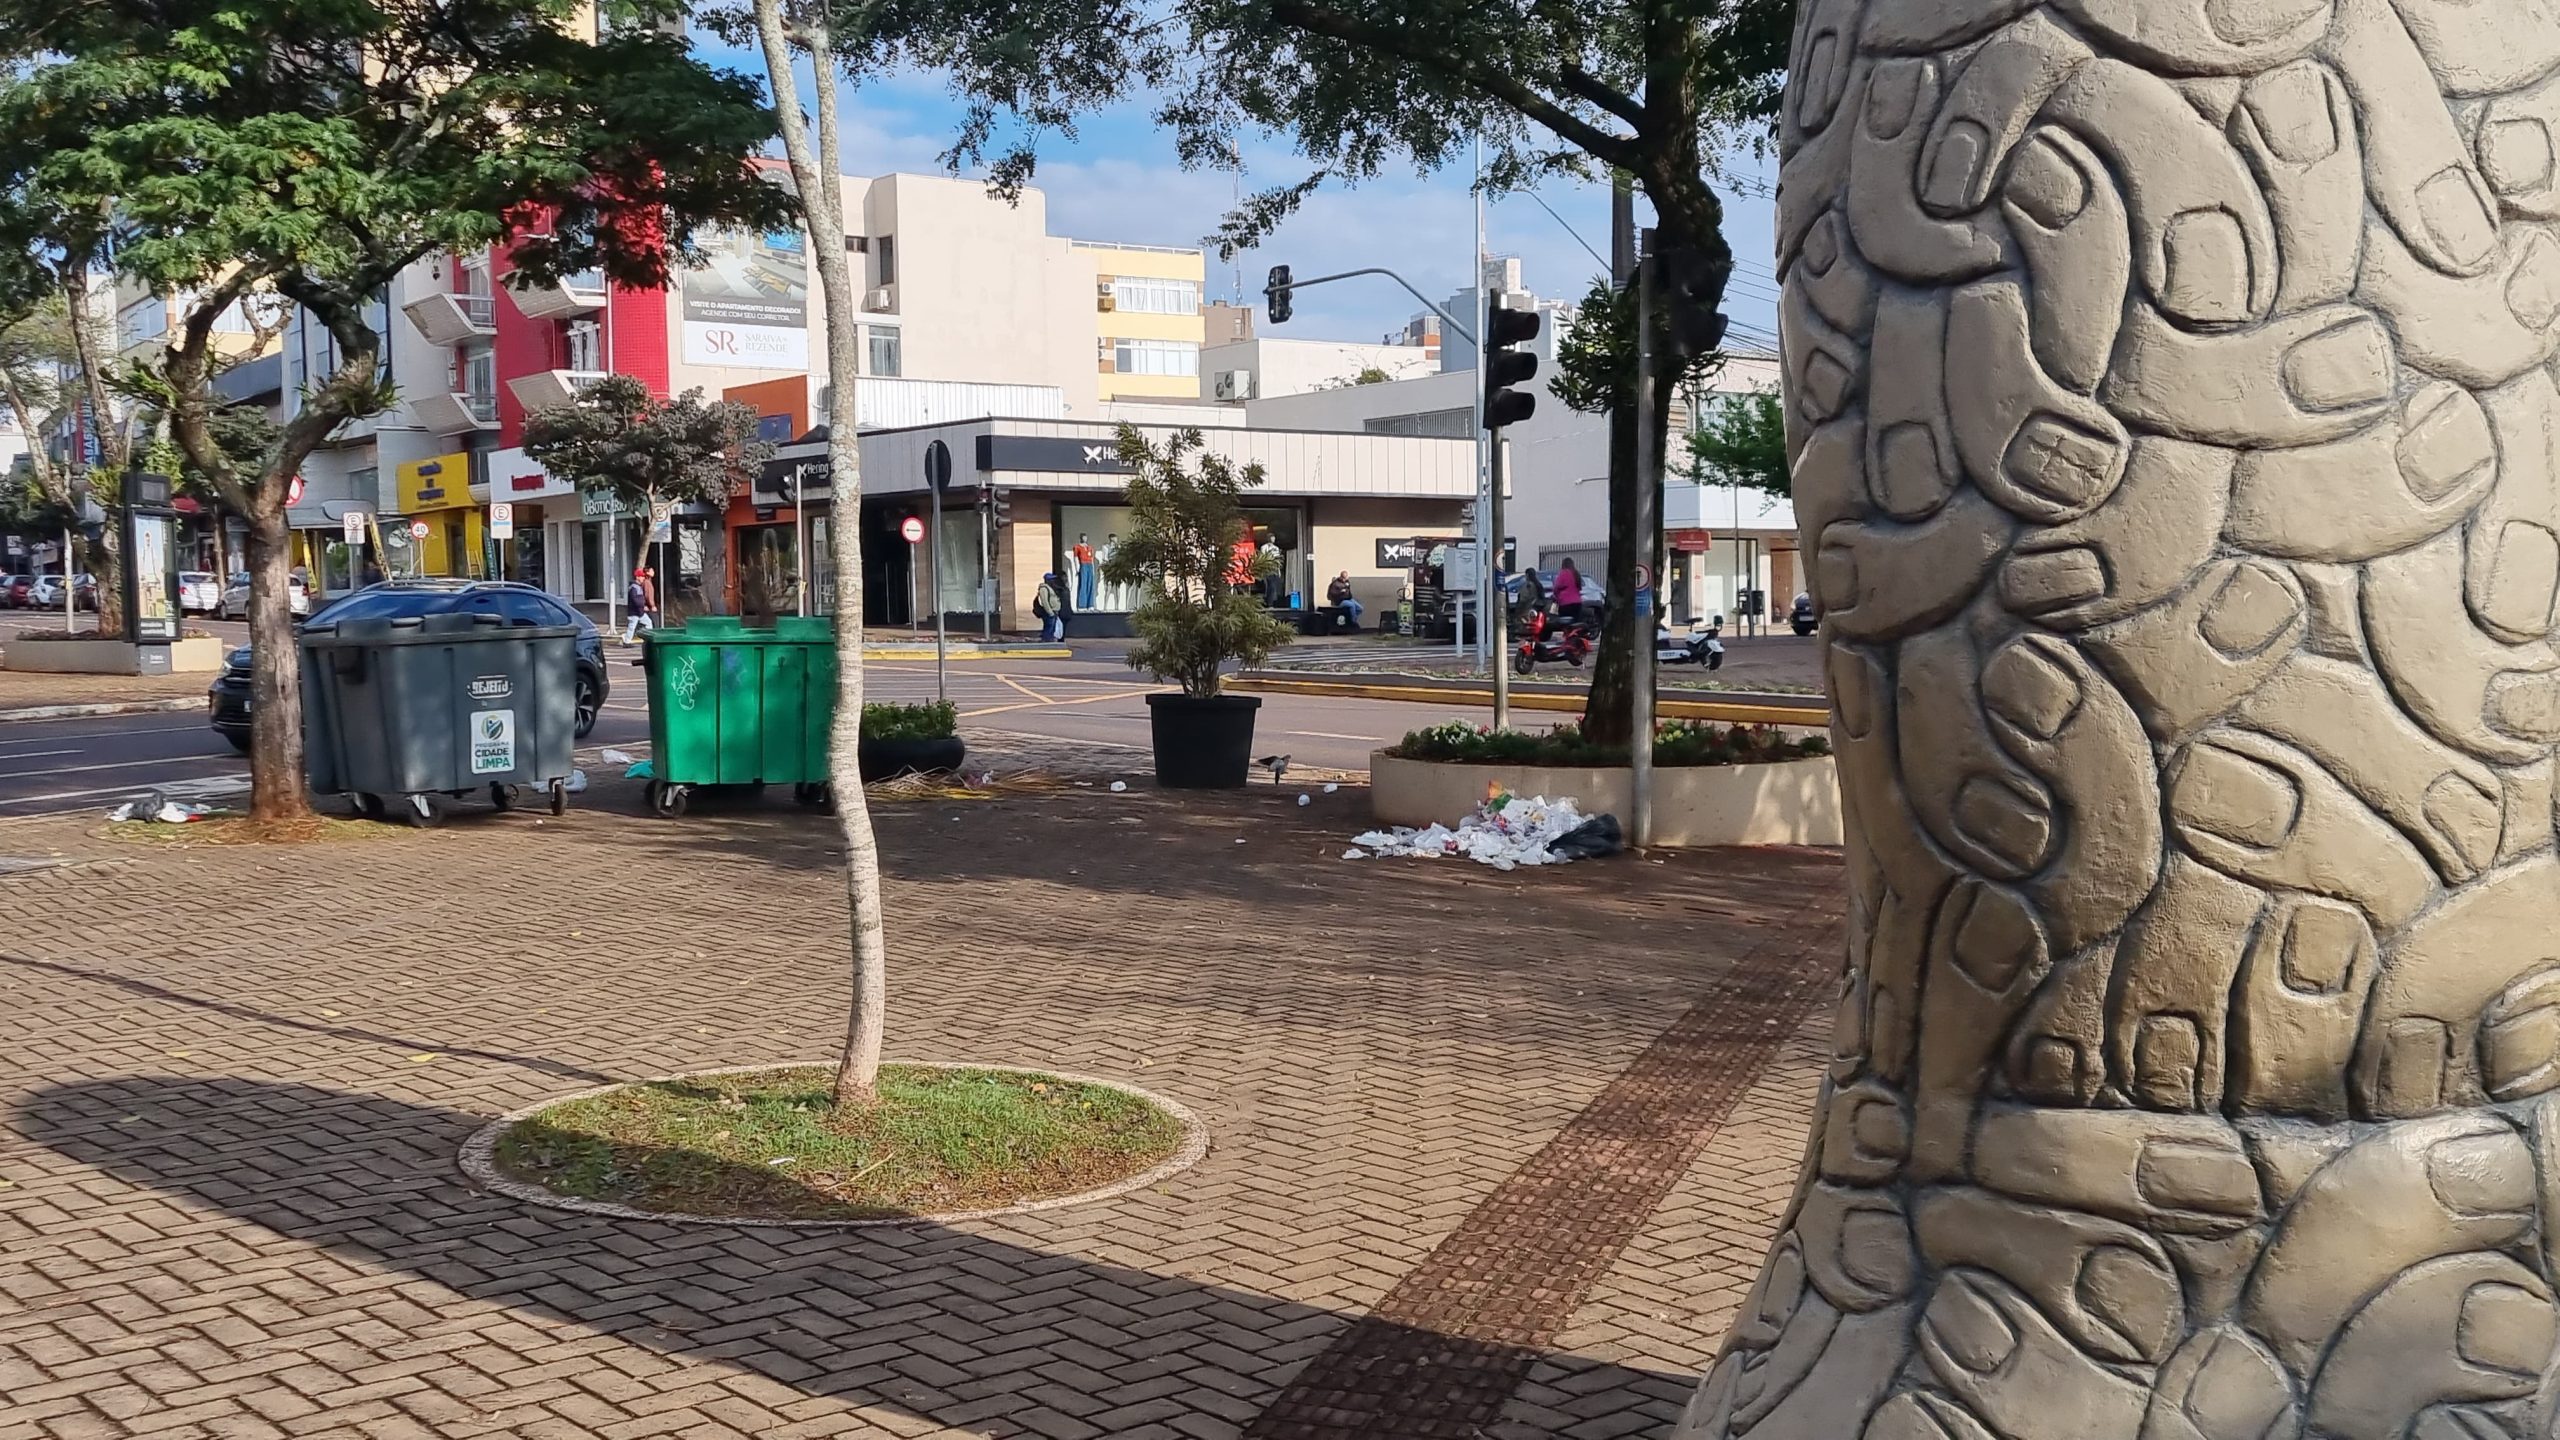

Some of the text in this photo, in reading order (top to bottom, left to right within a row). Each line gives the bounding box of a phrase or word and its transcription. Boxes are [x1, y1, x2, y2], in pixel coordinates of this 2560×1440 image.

[745, 333, 782, 343] SARAIVA
[745, 342, 788, 352] REZENDE
[807, 462, 829, 477] Hering
[415, 525, 426, 533] 40
[475, 748, 510, 758] CIDADE
[475, 757, 511, 770] LIMPA
